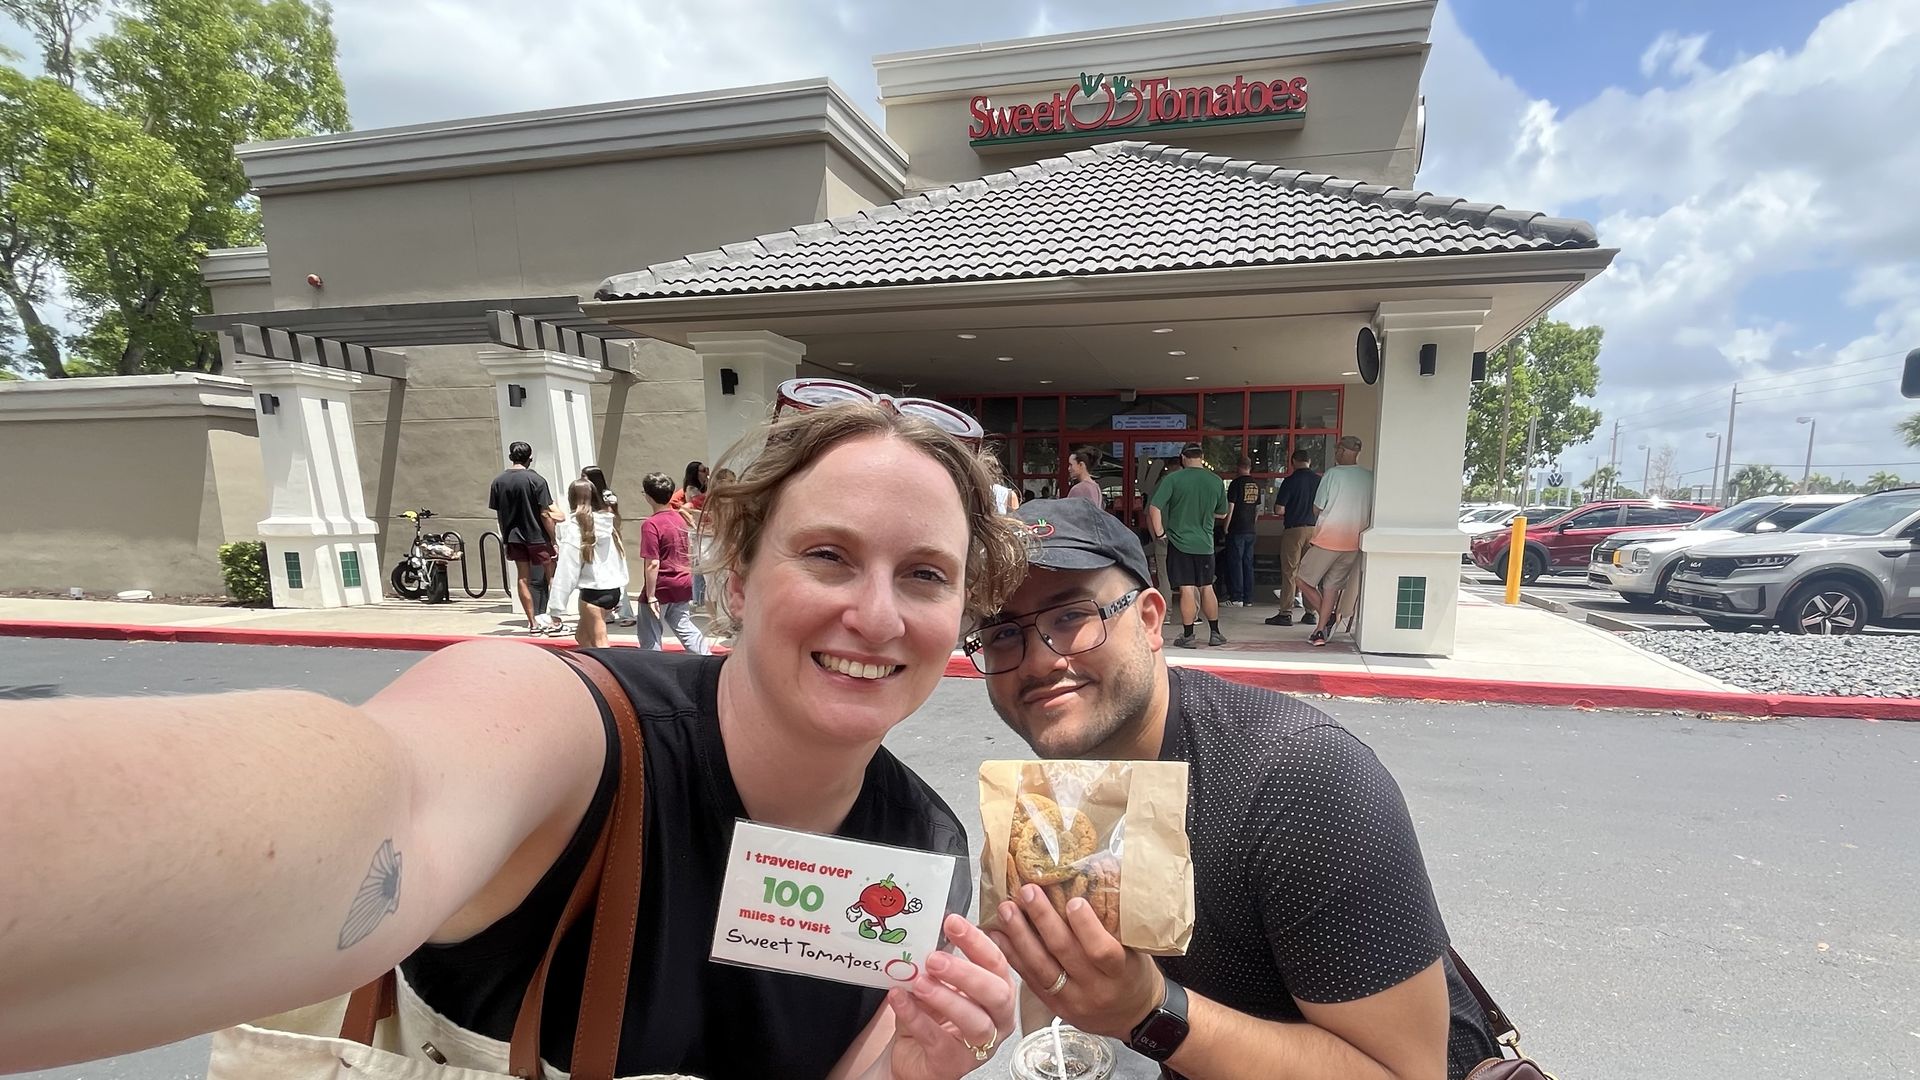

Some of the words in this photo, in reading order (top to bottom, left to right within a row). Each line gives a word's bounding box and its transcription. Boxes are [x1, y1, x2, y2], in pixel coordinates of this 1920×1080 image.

[969, 92, 1065, 138] Sweet
[1140, 75, 1308, 122] Tomatoes
[746, 851, 751, 861] I
[755, 852, 817, 873] traveled
[819, 864, 853, 879] over
[763, 876, 825, 912] 100
[739, 908, 775, 923] miles
[779, 916, 796, 928] to
[799, 920, 831, 935] visit
[726, 928, 793, 954] Sweet
